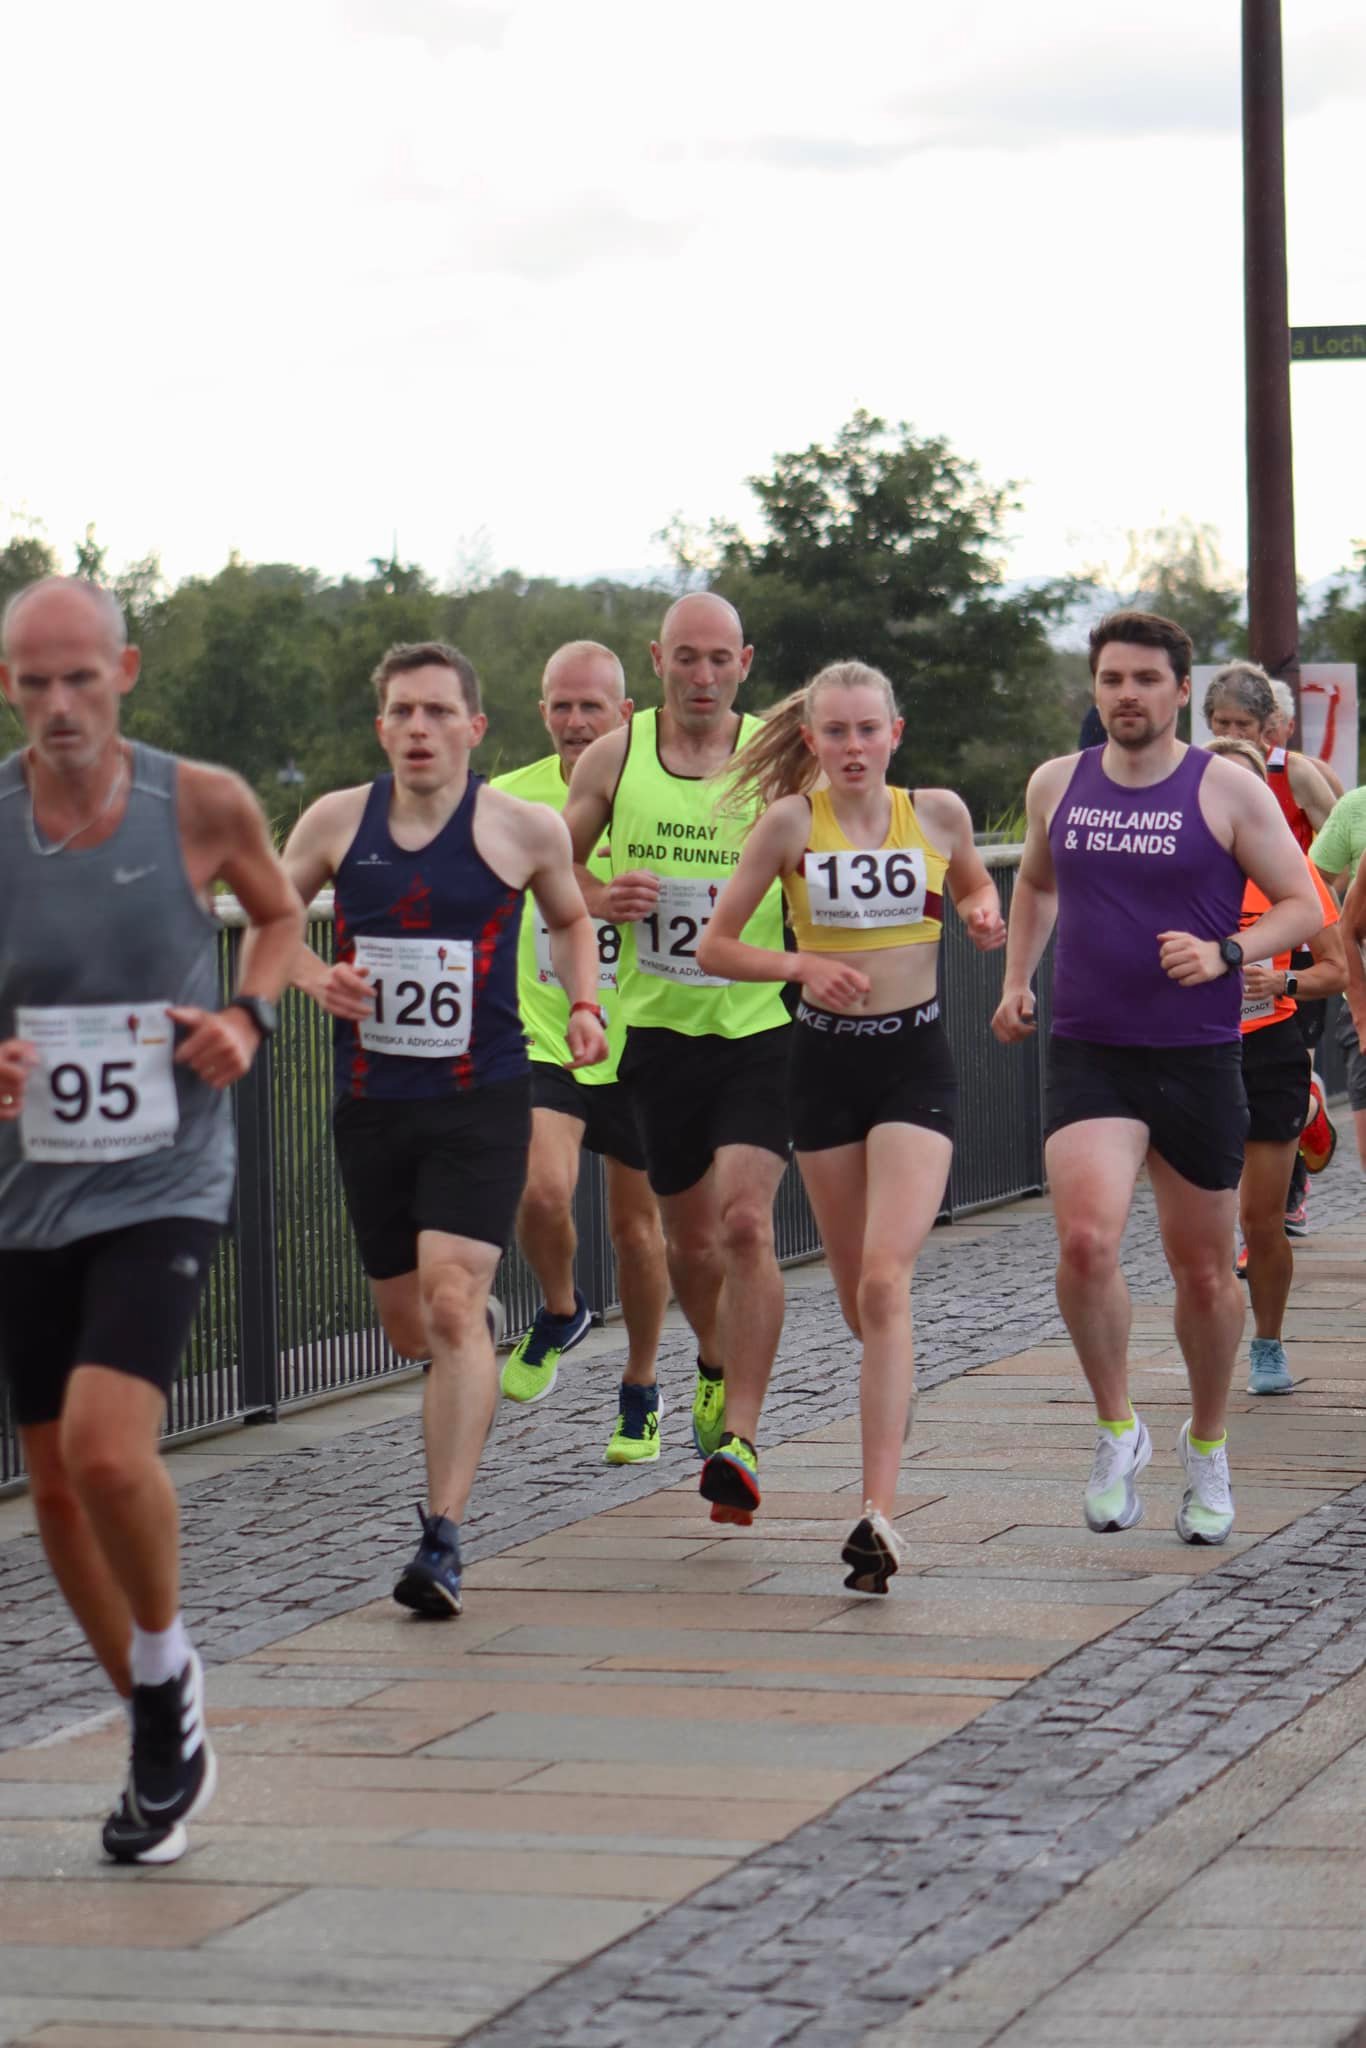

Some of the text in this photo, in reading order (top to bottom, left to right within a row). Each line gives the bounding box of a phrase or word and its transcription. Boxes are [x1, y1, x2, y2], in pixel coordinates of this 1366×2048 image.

[1312, 334, 1366, 354] Loch
[1067, 806, 1183, 831] HIGHLANDS
[656, 821, 718, 841] MORAY
[628, 843, 667, 860] ROAD
[1064, 830, 1177, 856] & ISLANDS
[817, 853, 916, 900] 136
[815, 906, 919, 920] KYNISKA ADVOCACY
[642, 912, 711, 958] 12
[640, 959, 678, 975] KYNISKA
[372, 977, 462, 1028] 126
[834, 1016, 903, 1037] PRO
[364, 1032, 464, 1048] KYNISKA ADVOCACY
[50, 1061, 138, 1123] 95
